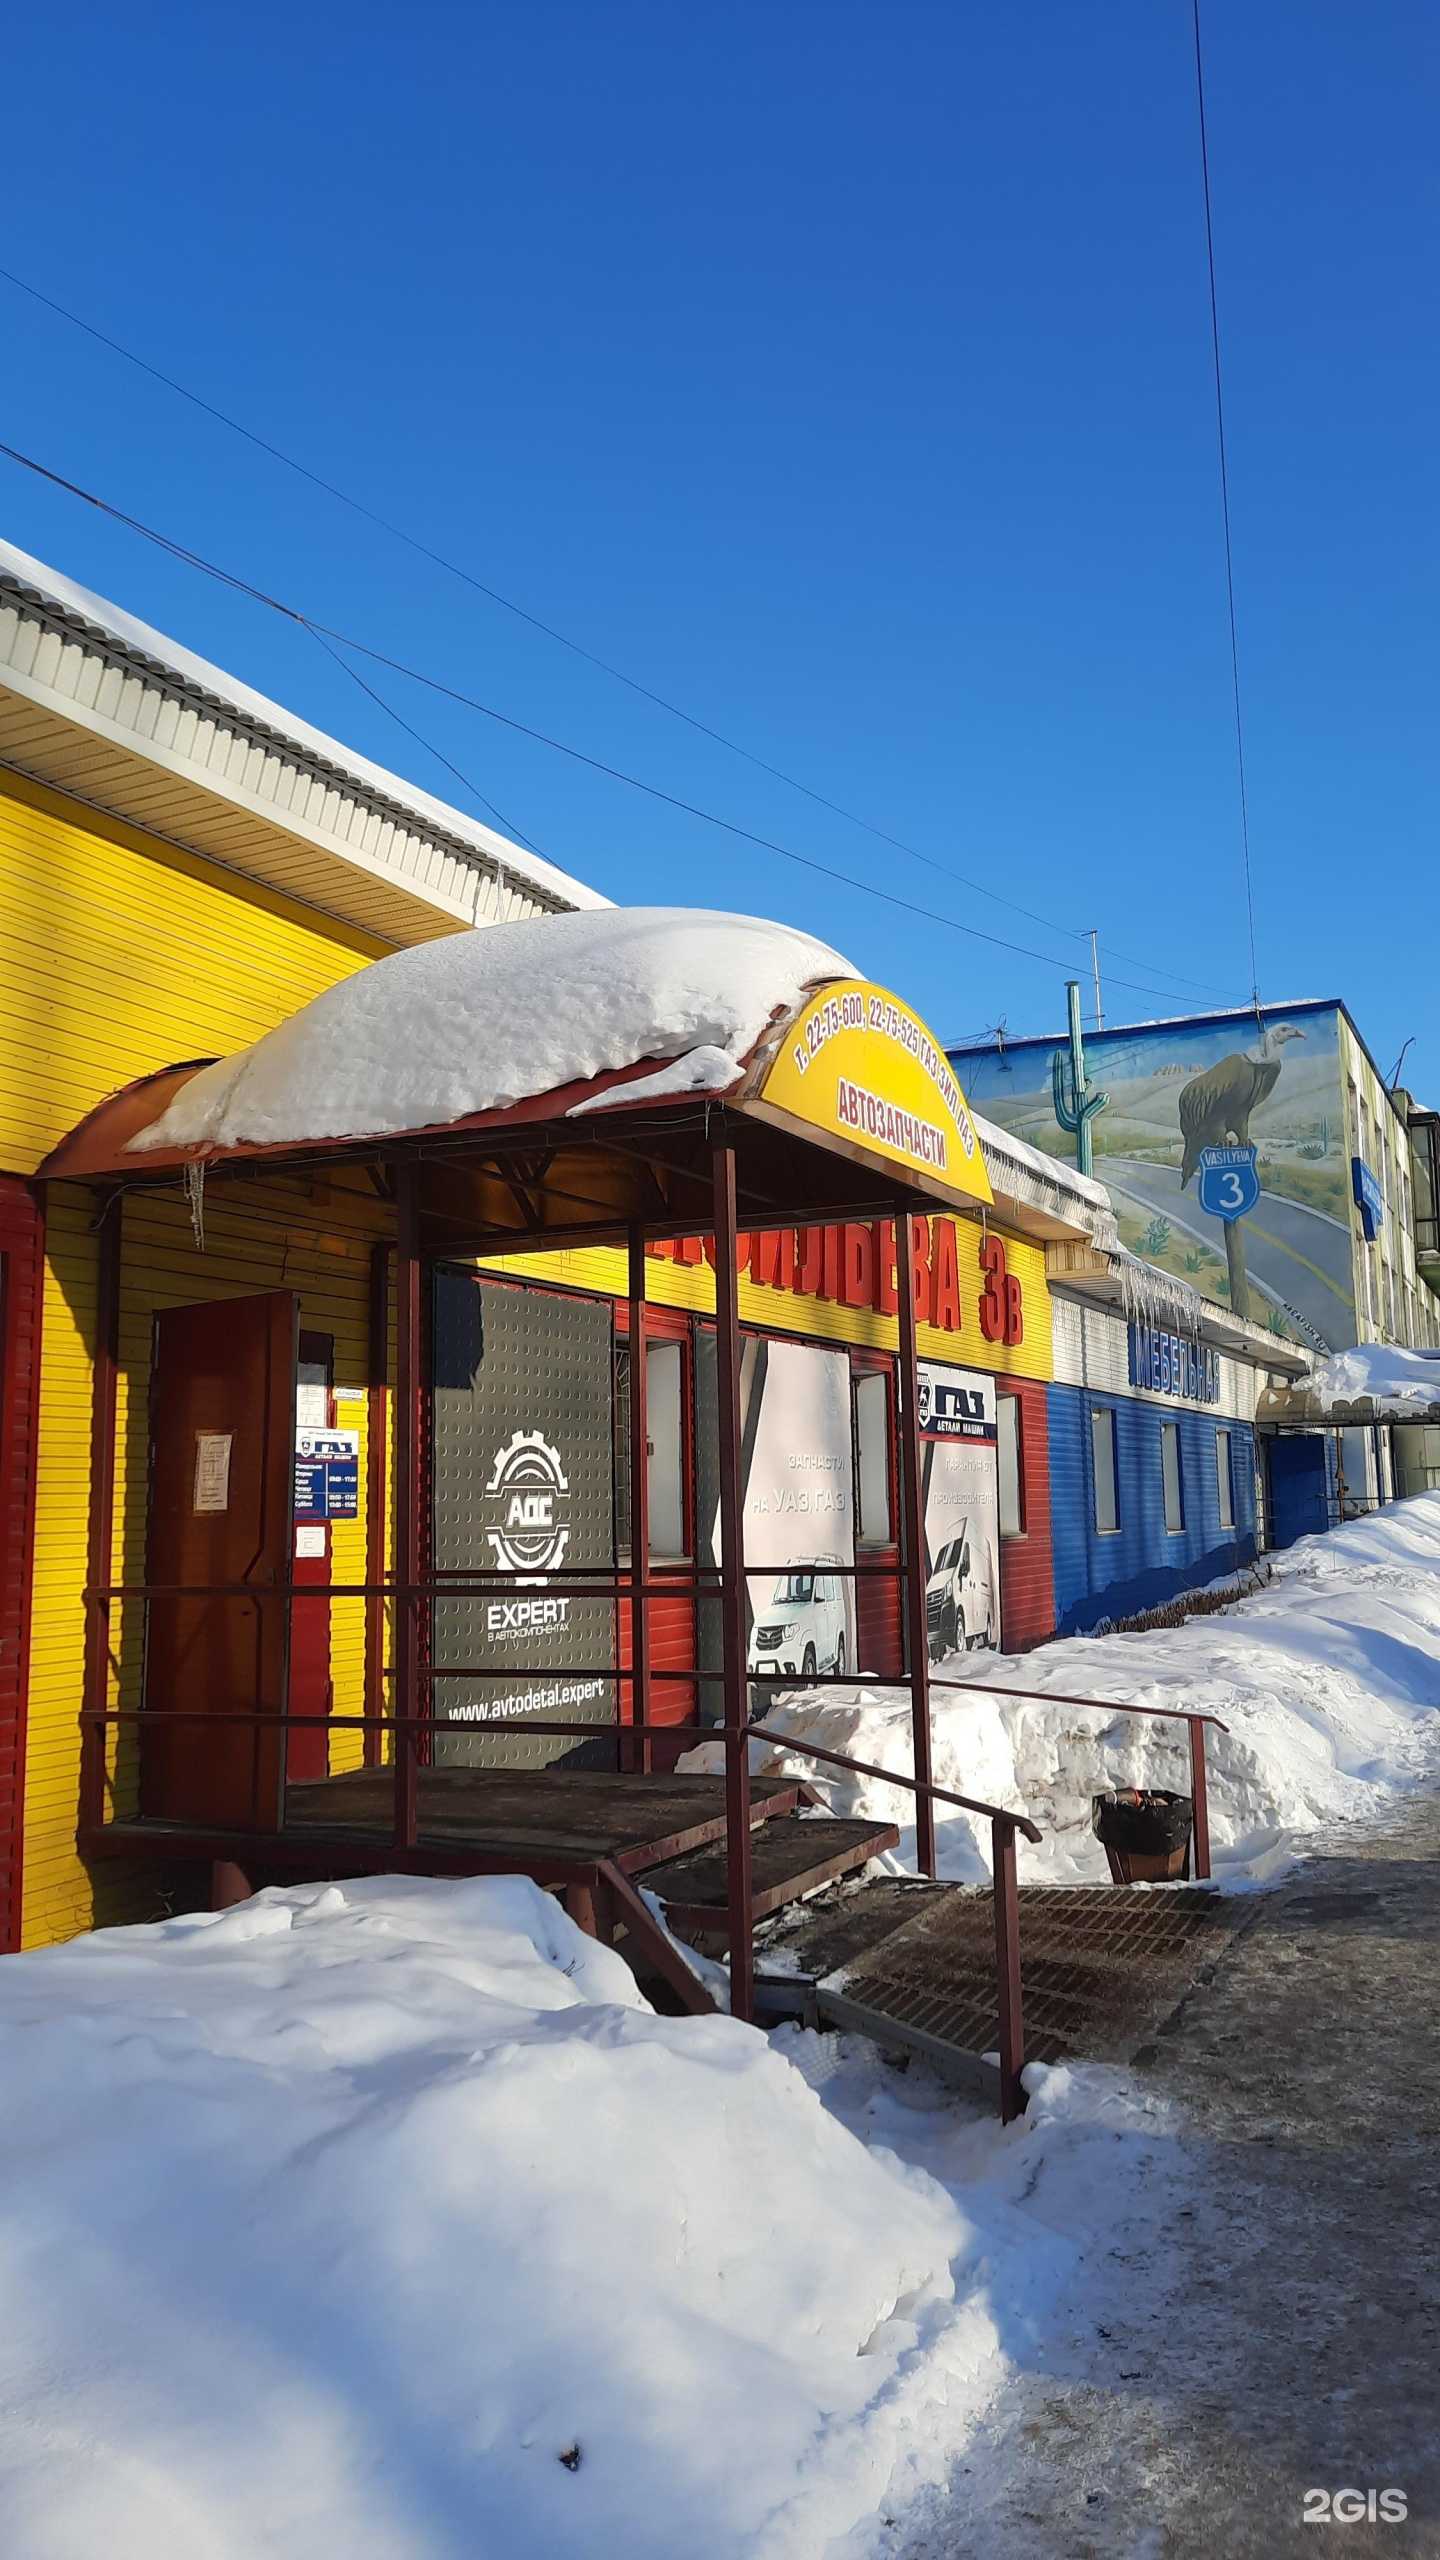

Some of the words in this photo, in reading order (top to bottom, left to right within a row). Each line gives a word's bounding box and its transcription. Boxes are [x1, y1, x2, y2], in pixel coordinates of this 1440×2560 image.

[869, 998, 919, 1054] 22-75-525
[920, 1038, 938, 1079] ГАЗ
[957, 1108, 974, 1156] ПАЗ
[838, 1079, 946, 1170] АВТОЗАПЧАСТИ
[1204, 1150, 1250, 1167] VASILYEVA
[1219, 1173, 1244, 1208] 3
[1130, 1323, 1221, 1404] МЕБЕЛЬНАЯ
[934, 1384, 985, 1420] ГАЗ
[314, 1441, 352, 1453] ГАЗ
[487, 1597, 570, 1630] EXPERT
[487, 1632, 495, 1642] В
[448, 1678, 605, 1721] www.avtodetal.expert
